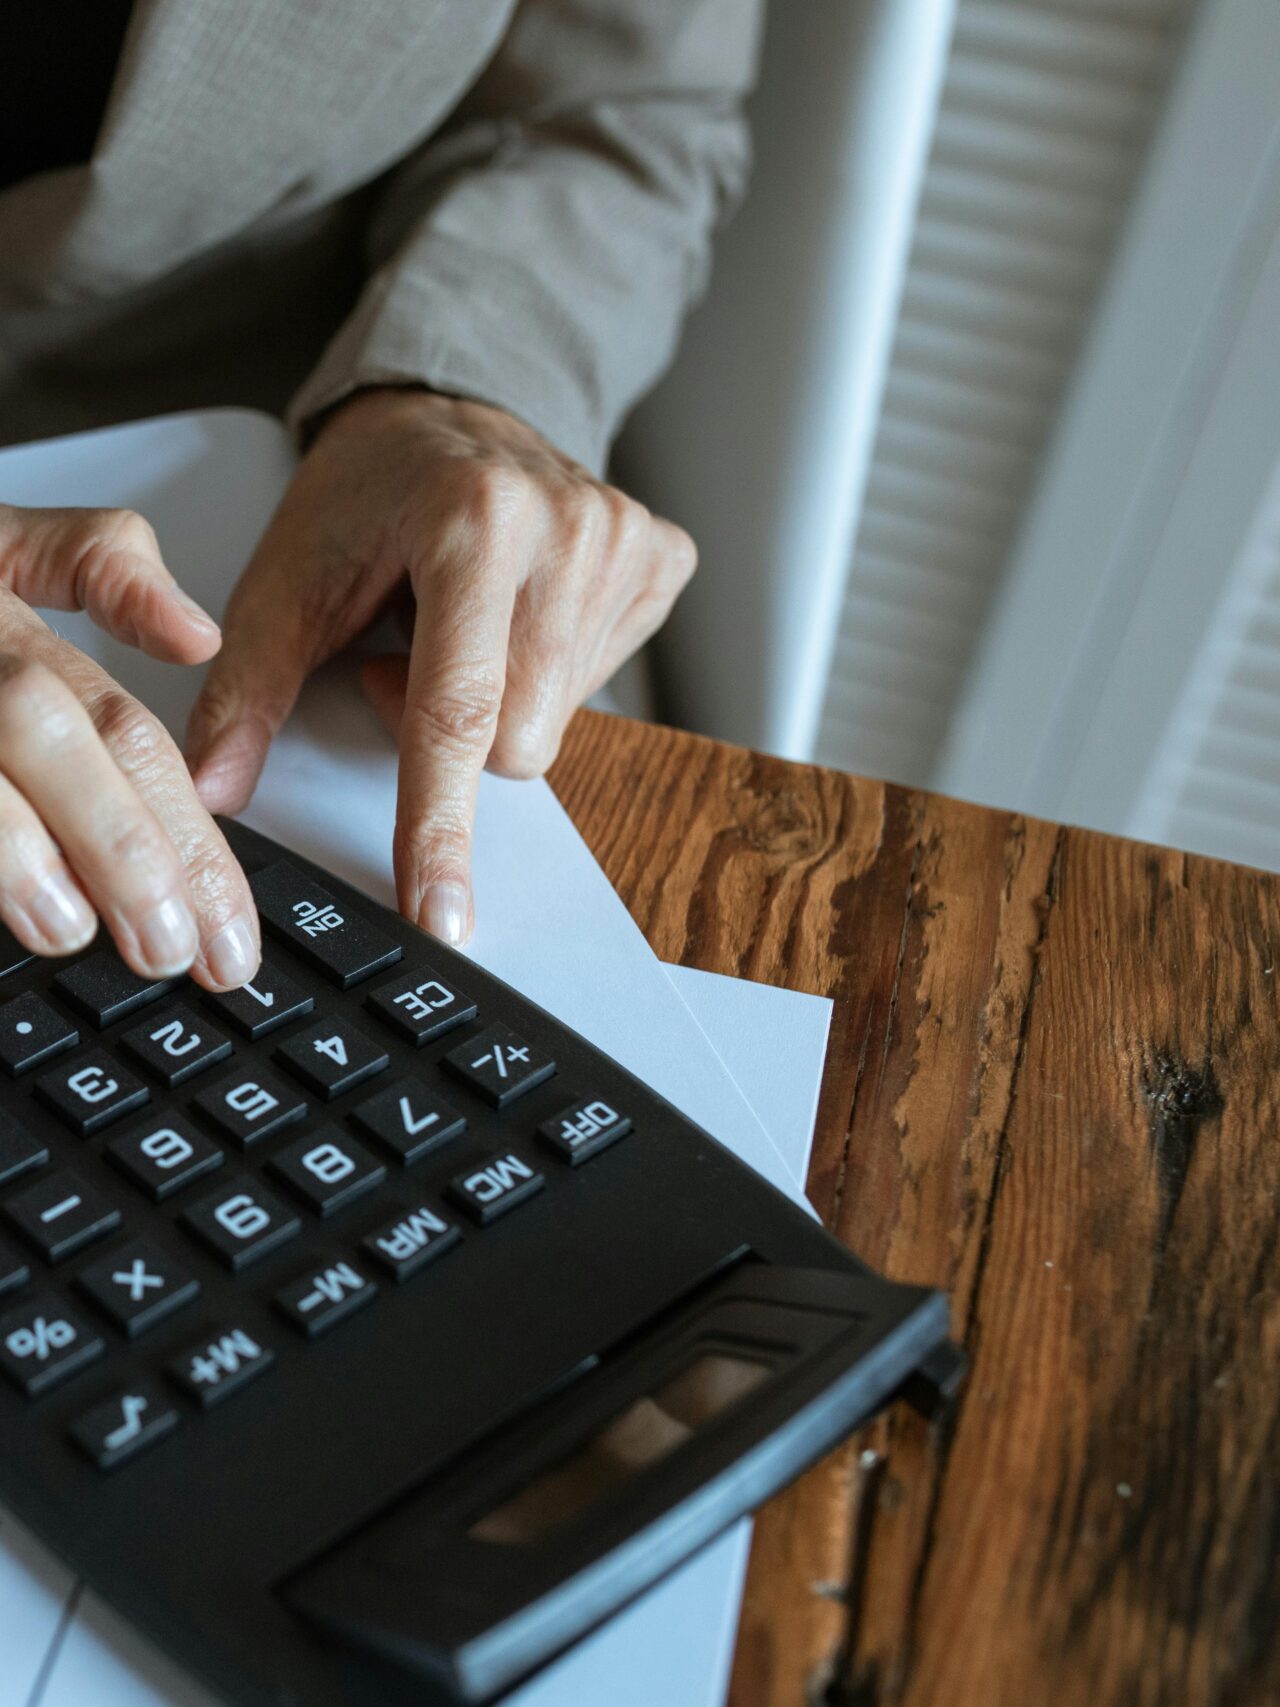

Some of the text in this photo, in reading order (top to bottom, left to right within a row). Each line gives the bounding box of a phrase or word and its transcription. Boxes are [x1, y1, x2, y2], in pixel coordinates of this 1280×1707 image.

[241, 981, 274, 1007] 1
[392, 980, 455, 1020] CE
[150, 1020, 201, 1056] 2
[313, 1035, 348, 1066] 4
[67, 1066, 118, 1103] 3
[225, 1082, 278, 1120] 5
[399, 1097, 439, 1134] 7
[561, 1101, 619, 1146] OFF
[140, 1129, 193, 1168] 6
[302, 1144, 355, 1183] 8
[464, 1155, 533, 1201] MC
[215, 1195, 269, 1237] 9
[378, 1209, 446, 1258] MR
[6, 1317, 75, 1358] %
[192, 1329, 260, 1383] M+
